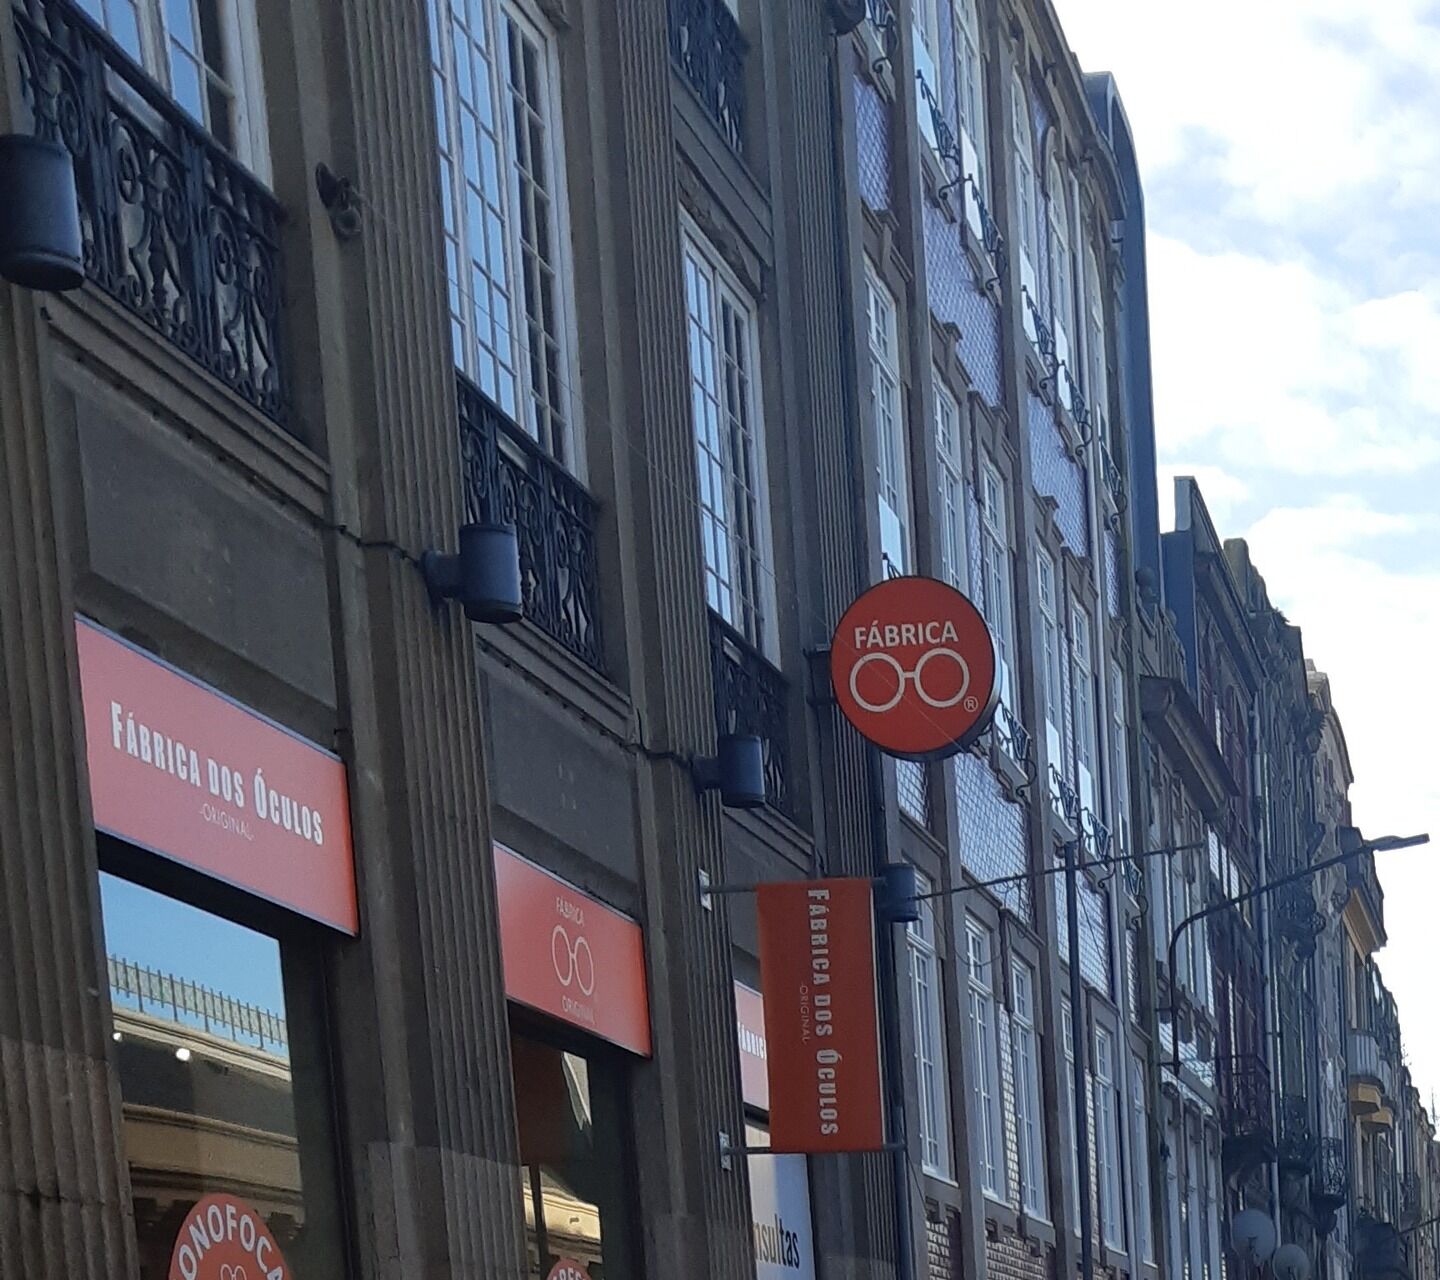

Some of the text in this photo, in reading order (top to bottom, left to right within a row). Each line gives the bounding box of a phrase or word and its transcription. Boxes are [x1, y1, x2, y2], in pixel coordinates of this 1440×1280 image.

[854, 620, 959, 649] FÁBRICA
[111, 701, 324, 846] FÁBRICA DOS ÓCULOS
[807, 889, 843, 1136] FÁBRICA DOS ÓCULOS
